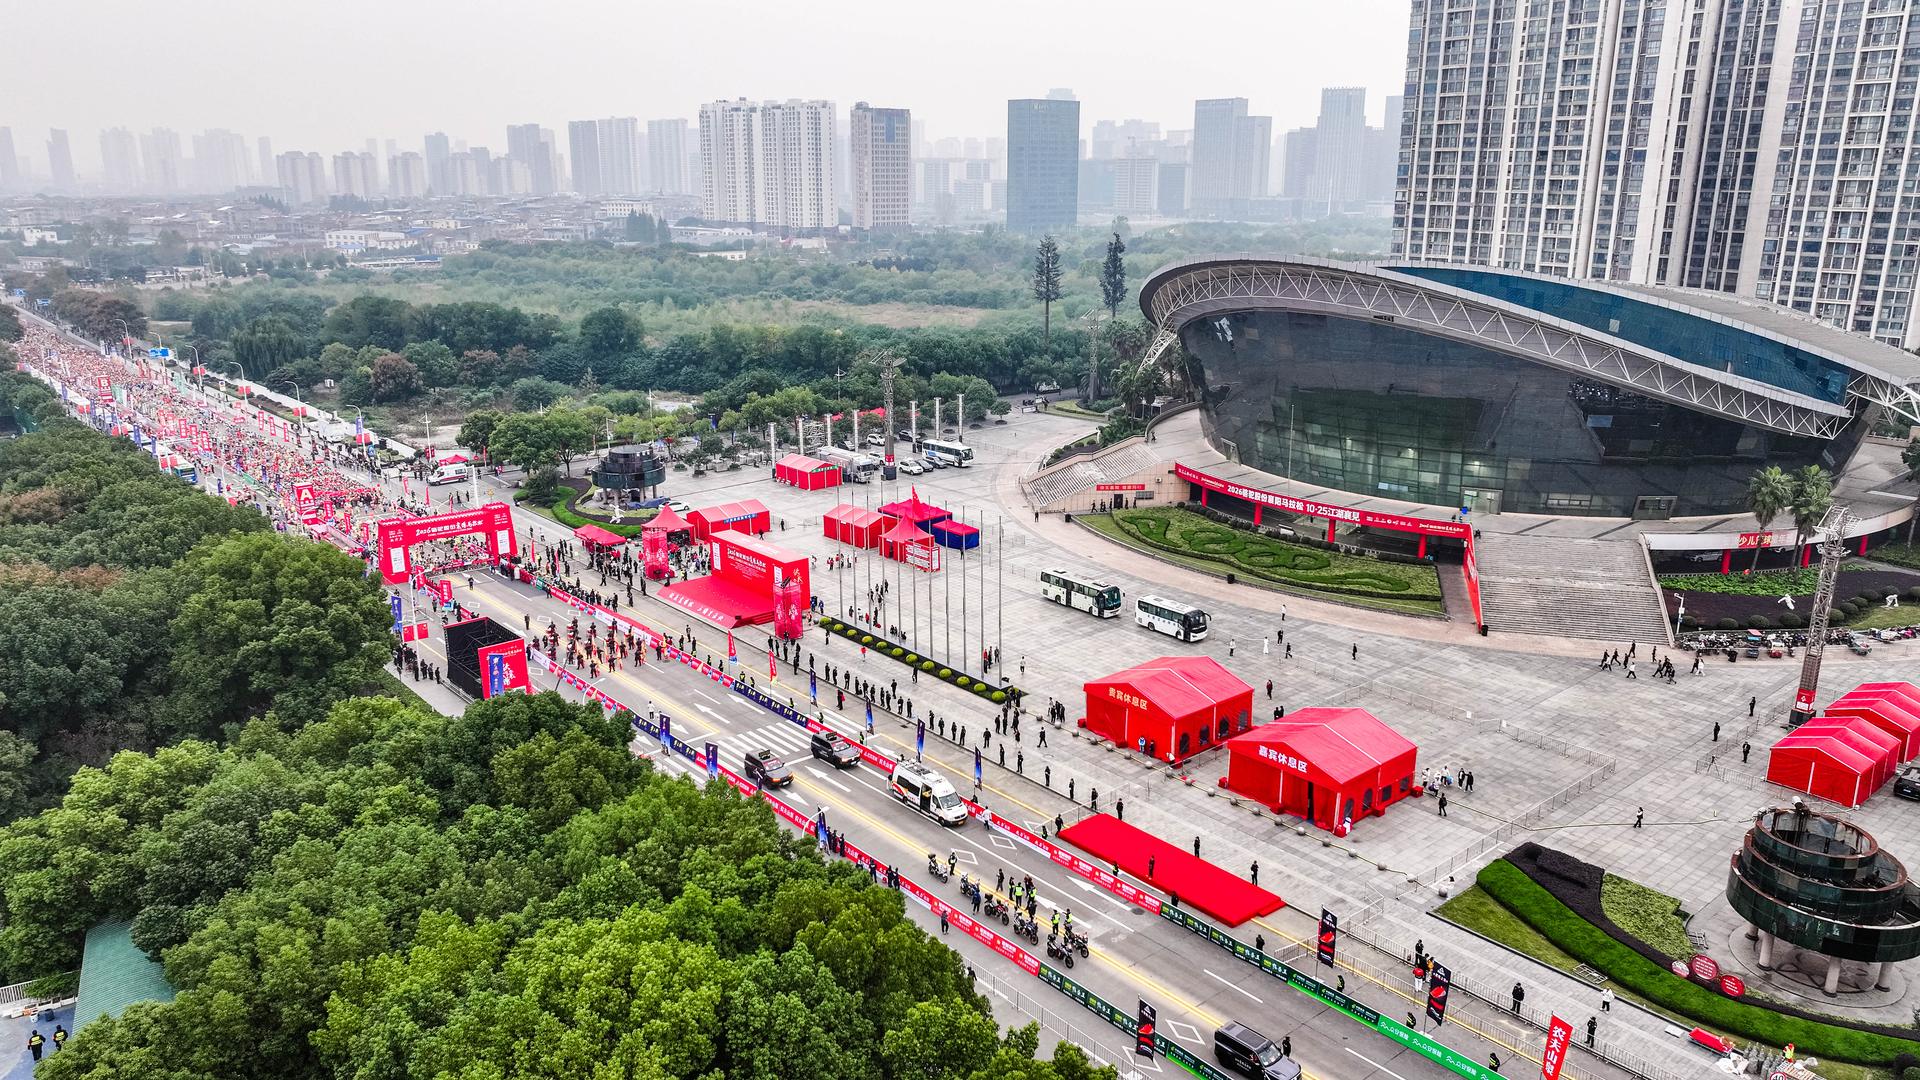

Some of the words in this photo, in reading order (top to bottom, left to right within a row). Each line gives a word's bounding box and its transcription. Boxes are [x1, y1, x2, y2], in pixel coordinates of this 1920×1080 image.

[300, 489, 314, 501] A
[1227, 485, 1304, 511] 2026骆驼股份襄阳马拉松
[1258, 744, 1308, 773] 嘉宾休息区
[1545, 1025, 1567, 1077] 农夫山泉
